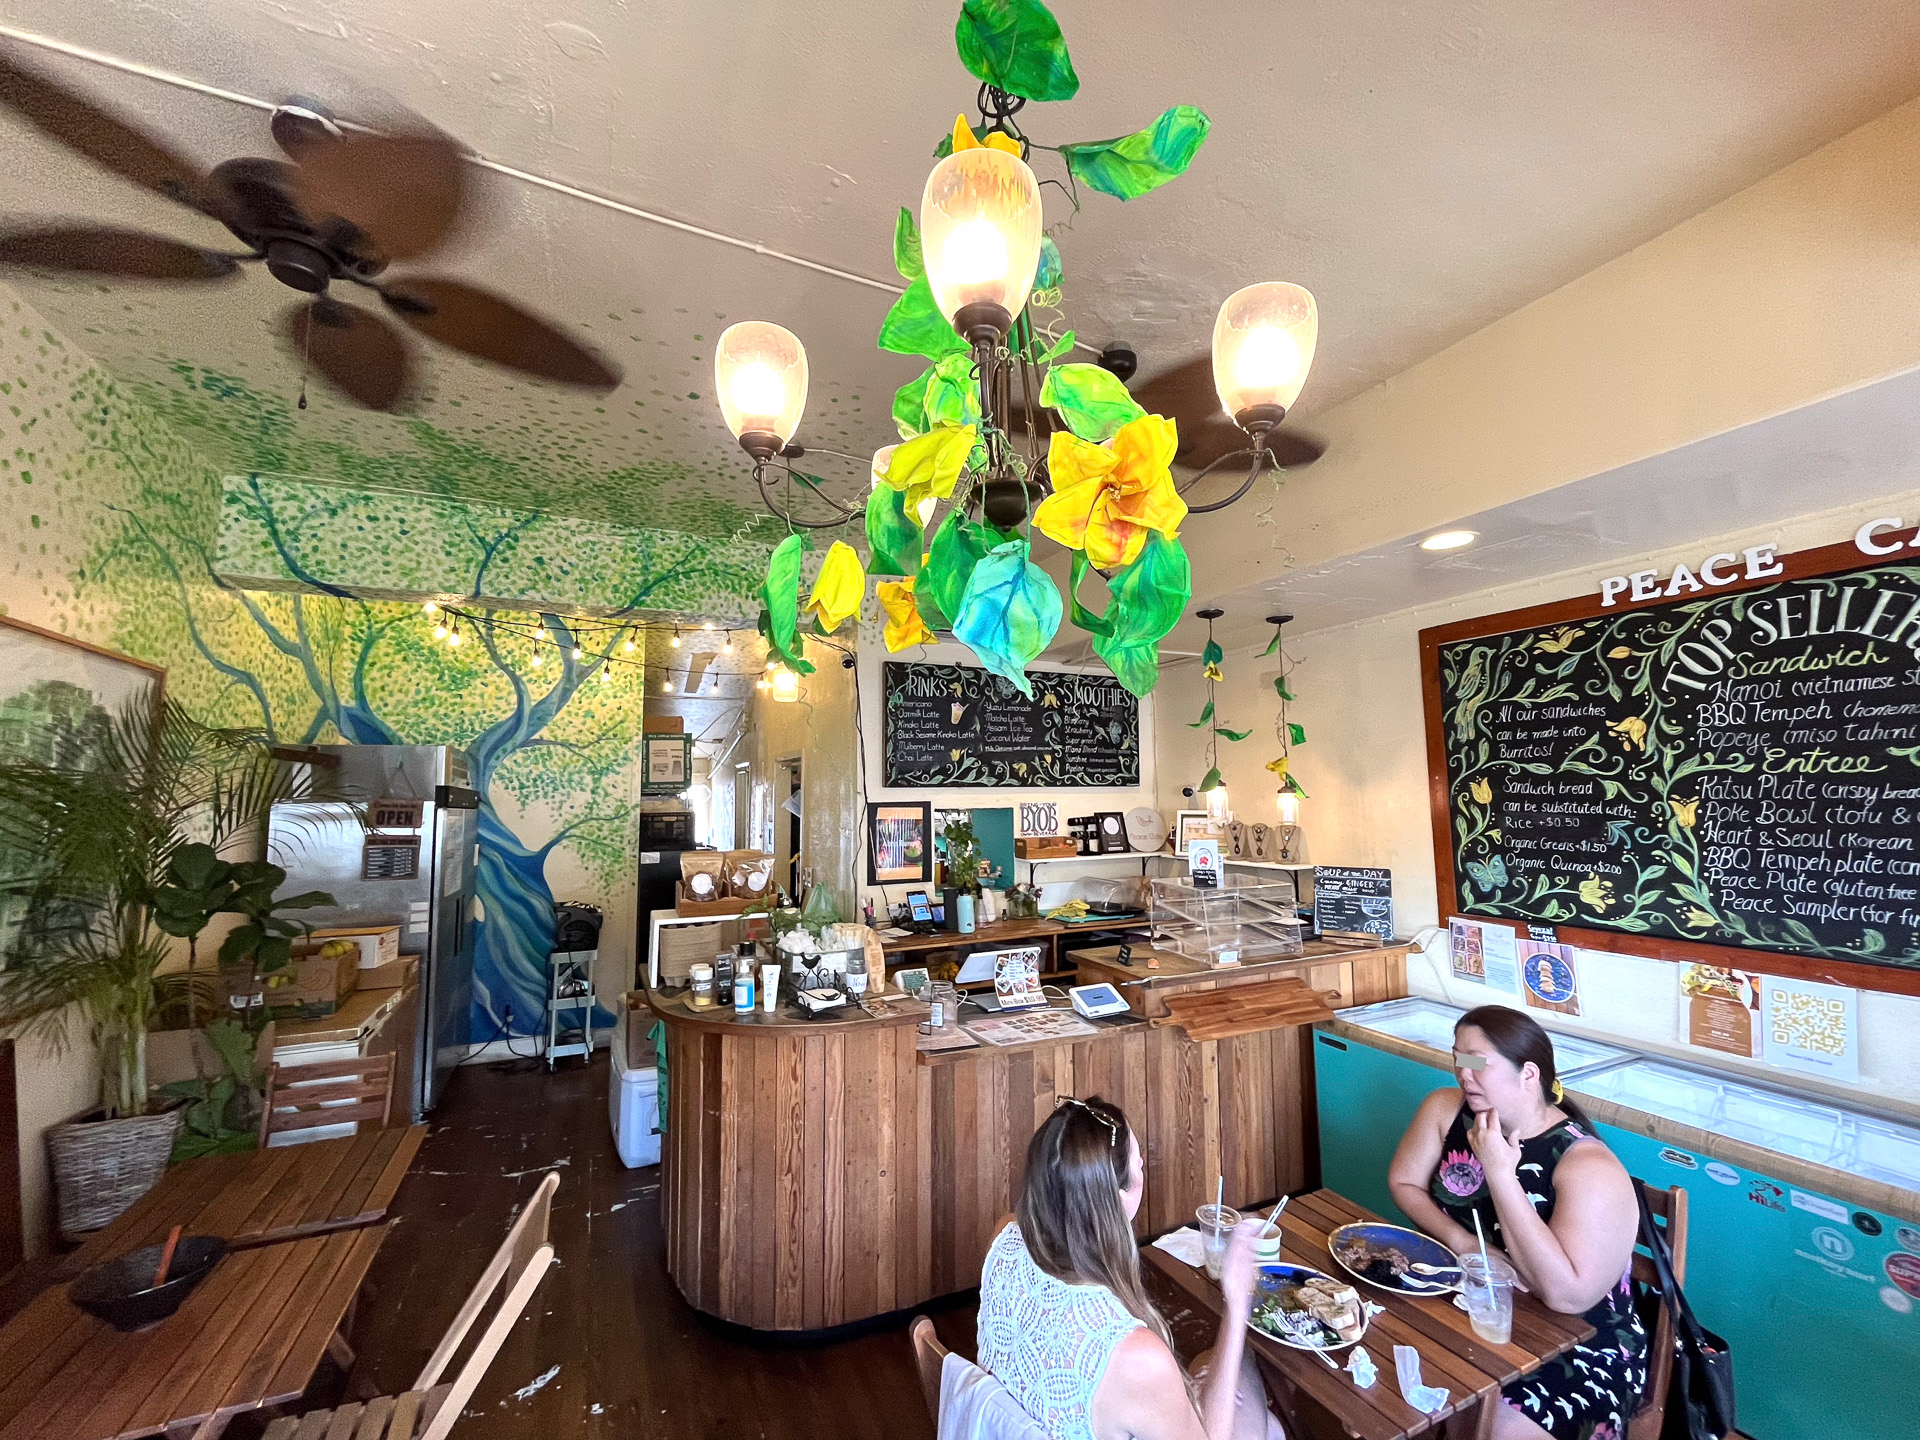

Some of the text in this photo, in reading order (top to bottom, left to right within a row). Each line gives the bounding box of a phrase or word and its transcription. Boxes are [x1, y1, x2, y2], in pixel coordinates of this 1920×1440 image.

[1600, 542, 1783, 607] PEACE
[1662, 586, 1920, 692] TOP SELLER
[1728, 641, 1890, 679] Sandwich
[904, 674, 948, 698] RINKS
[1063, 682, 1130, 707] SMOOTHIES
[1709, 679, 1783, 704] Hanoi
[986, 701, 1032, 712] Yuzu Lemonade
[1495, 703, 1606, 723] All our sandwiches
[1696, 702, 1747, 727] BBQ
[1749, 698, 1833, 727] Tempeh
[921, 720, 940, 728] Latte
[985, 713, 1025, 722] Matcha Latte
[985, 722, 1033, 733] Assam Ice Tea
[897, 730, 914, 739] Black
[915, 730, 936, 739] Sesame
[958, 731, 975, 739] Latte
[985, 732, 1031, 742] Coconut Water
[1496, 725, 1587, 741] can be made into
[1696, 727, 1772, 758] Popeye
[1783, 727, 1837, 744] (miso
[898, 740, 945, 751] Mulberry Latte
[1499, 742, 1554, 759] Burritos!
[897, 751, 934, 761] Chai Latte
[1762, 746, 1888, 773] Entree
[1503, 776, 1593, 796] Sandwich bread
[1698, 775, 1754, 800] Katsu
[1758, 774, 1817, 800] Plate
[1822, 782, 1879, 806] (crispy
[376, 810, 414, 826] OPEN
[1020, 806, 1058, 832] BYOB
[1503, 800, 1637, 819] can be substituted with:
[1704, 800, 1911, 825] Poke Bowl (tofu &
[1505, 816, 1534, 829] Rice
[1504, 834, 1538, 853] Organic
[1540, 836, 1575, 852] Greens
[1703, 820, 1752, 845] Heart
[1759, 831, 1774, 846] &
[1775, 827, 1834, 849] Seoul
[1506, 853, 1546, 873] Organic
[1551, 855, 1592, 873] Quinoa
[1704, 846, 1751, 871] BBQ
[1756, 847, 1831, 876] Tempeh
[1834, 850, 1884, 876] plate
[1363, 870, 1384, 878] DAY
[1709, 867, 1918, 900] Peace Plate (gluten free
[1720, 889, 1777, 914] Peace
[1783, 894, 1860, 924] Sampler
[1861, 903, 1895, 924] (for
